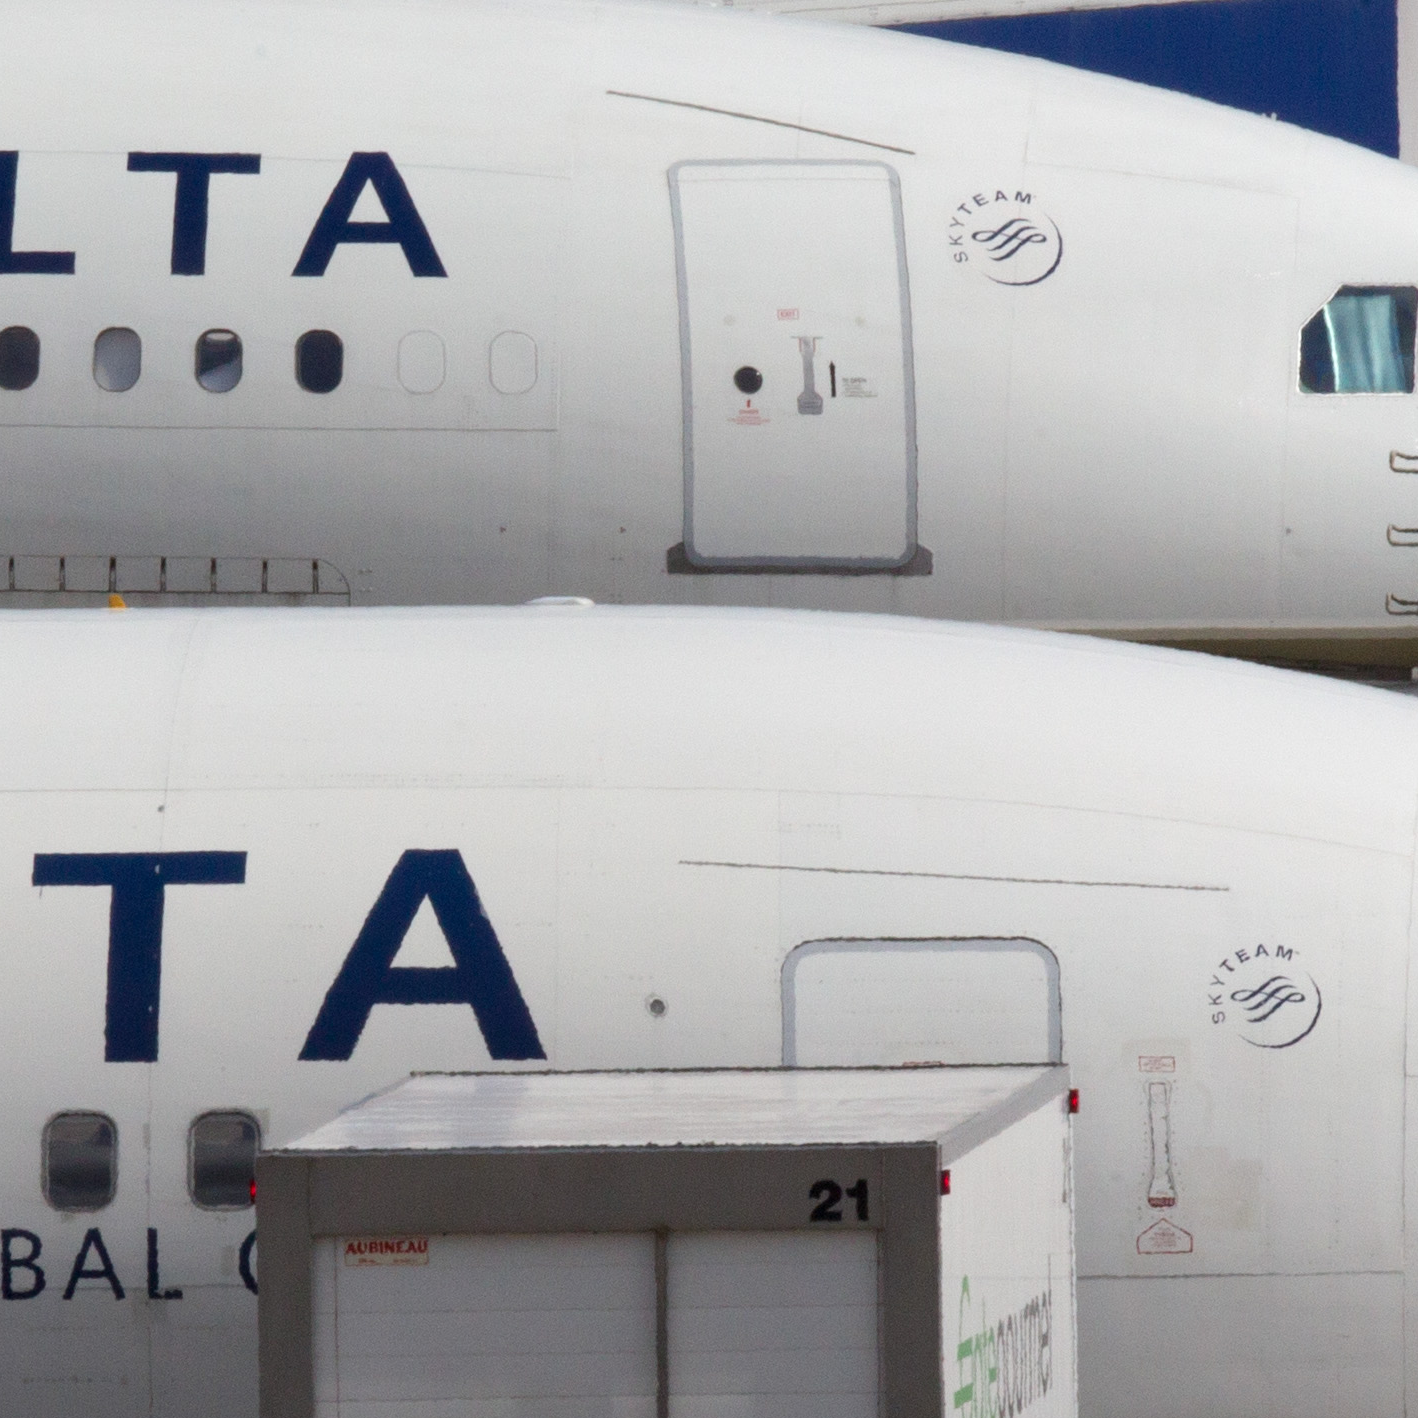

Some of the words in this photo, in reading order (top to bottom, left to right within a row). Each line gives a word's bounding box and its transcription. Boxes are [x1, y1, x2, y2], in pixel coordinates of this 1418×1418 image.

[948, 190, 1032, 263] SKYTEAM
[1208, 943, 1294, 1025] SKYTEAM
[808, 1178, 869, 1222] 21
[345, 1240, 429, 1255] AUBINEAU
